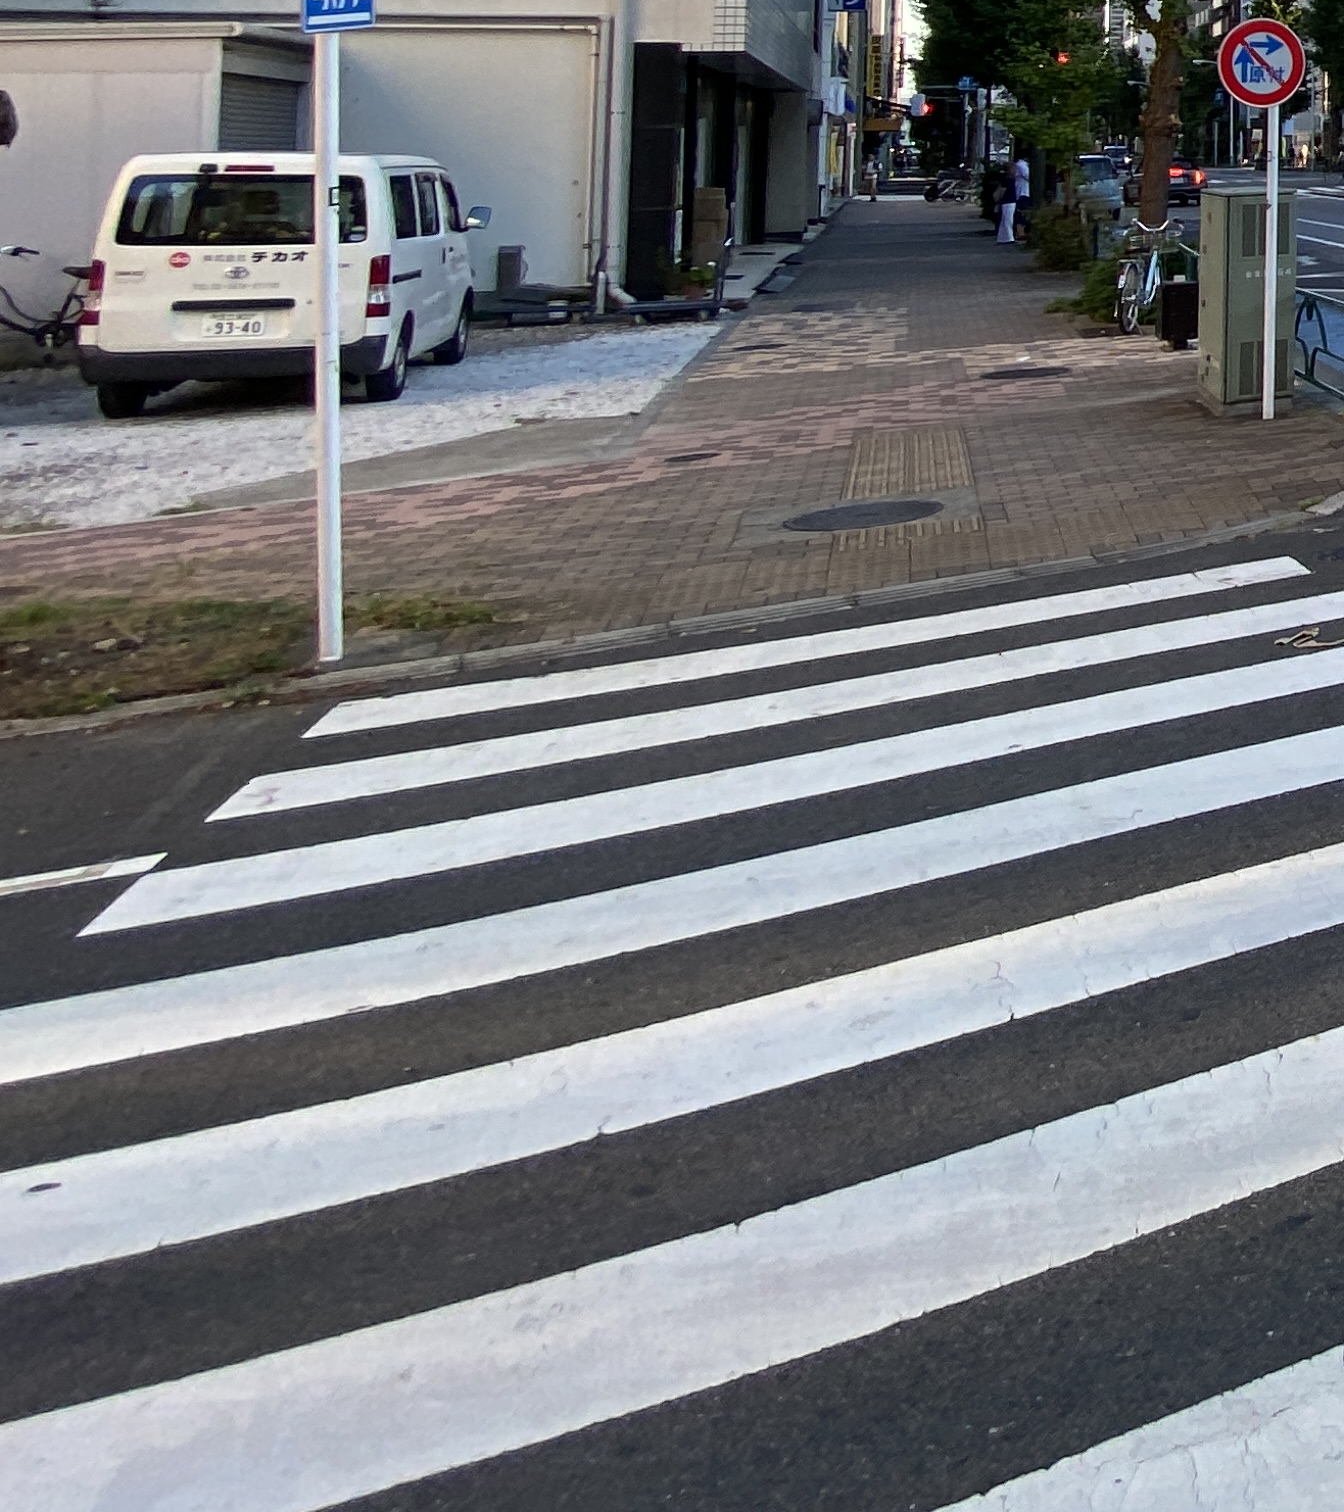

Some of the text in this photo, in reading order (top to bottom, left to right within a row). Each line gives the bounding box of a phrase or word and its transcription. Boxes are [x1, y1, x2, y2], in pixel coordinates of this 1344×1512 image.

[1249, 65, 1285, 84] 原付
[251, 251, 309, 263] テカオ
[214, 321, 262, 335] 93-40
